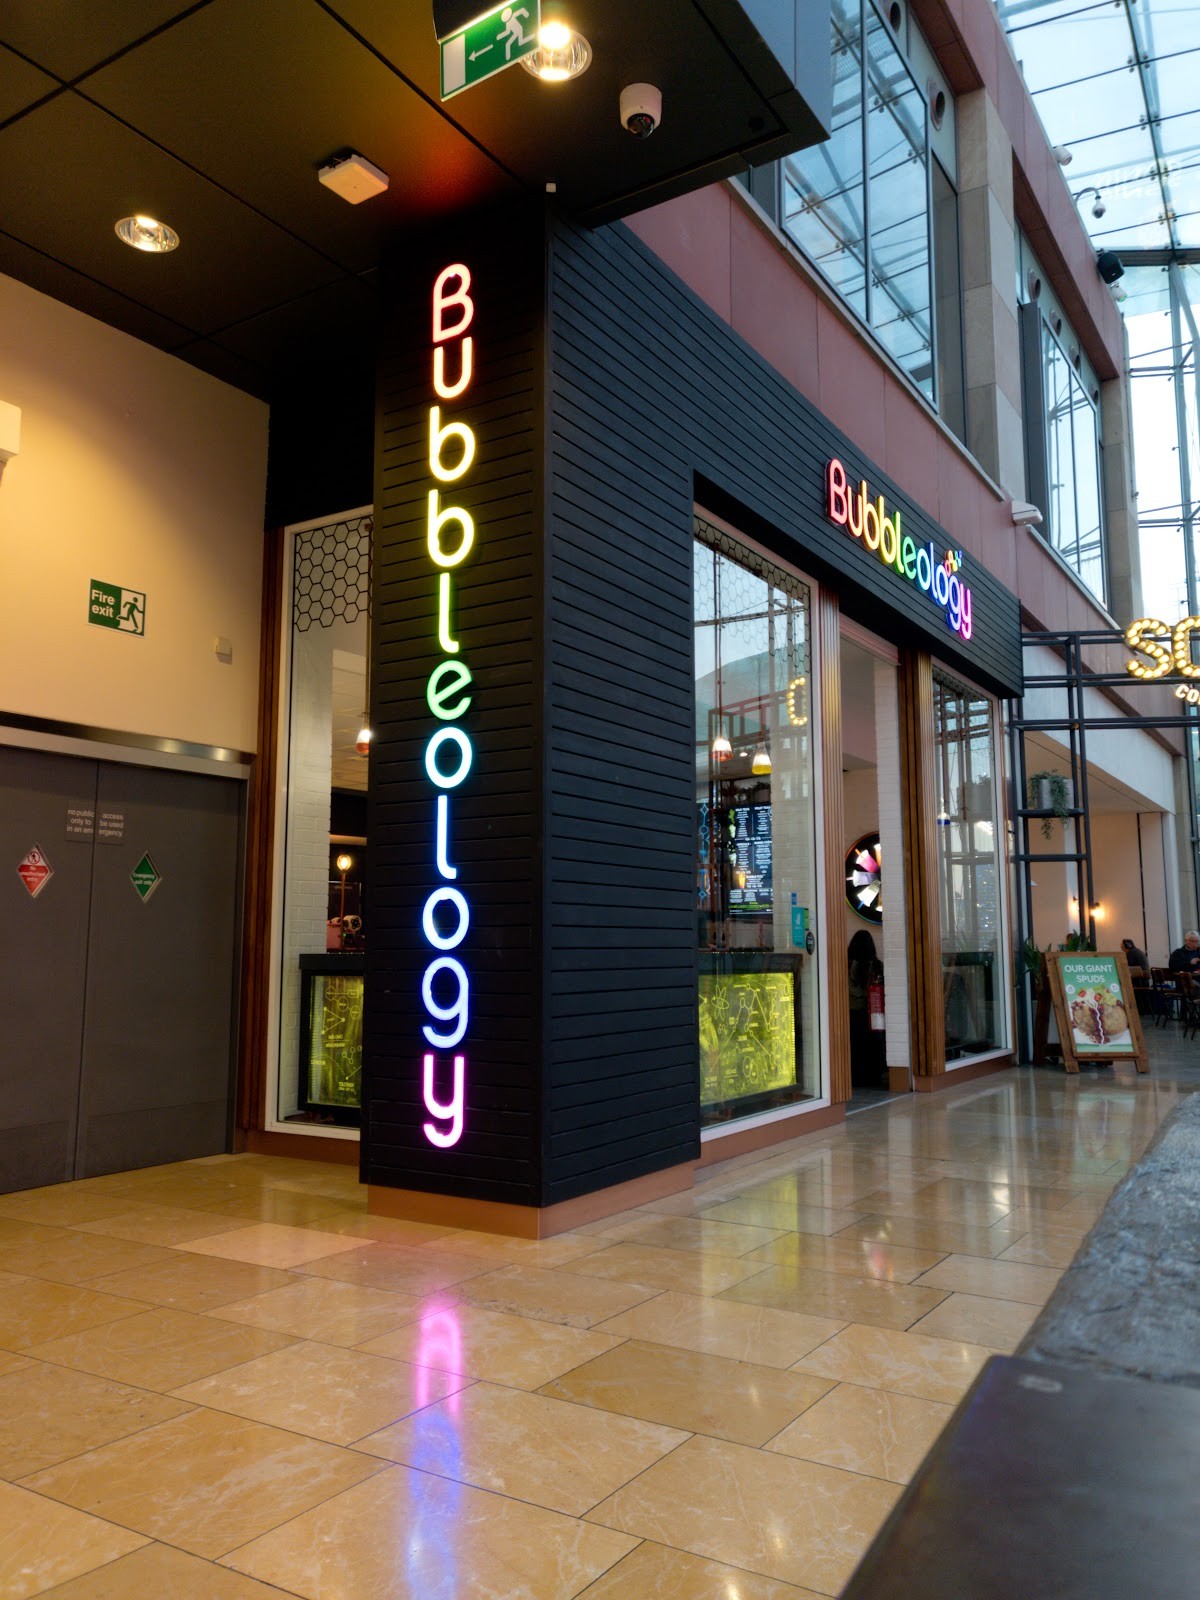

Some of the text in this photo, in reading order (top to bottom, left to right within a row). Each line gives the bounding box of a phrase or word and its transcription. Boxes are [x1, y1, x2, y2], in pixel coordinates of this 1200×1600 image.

[825, 458, 972, 641] Bubbleology
[91, 589, 115, 606] Fire
[91, 604, 114, 618] exit
[421, 263, 476, 1149] Bubbleology
[76, 810, 95, 818] public
[70, 818, 84, 826] only
[1064, 963, 1113, 973] OUR GIANT
[1076, 975, 1106, 983] SPUDS
